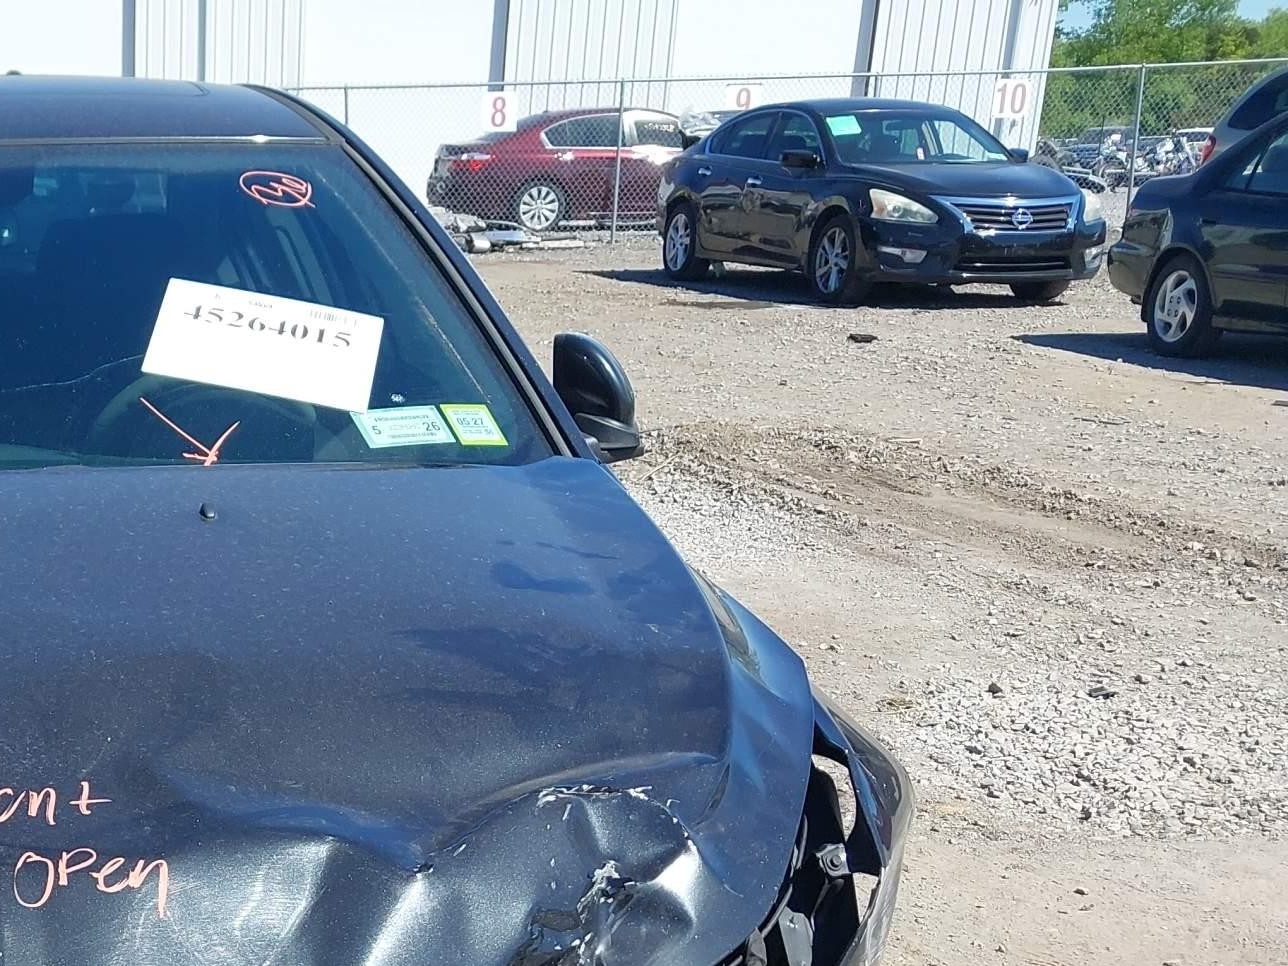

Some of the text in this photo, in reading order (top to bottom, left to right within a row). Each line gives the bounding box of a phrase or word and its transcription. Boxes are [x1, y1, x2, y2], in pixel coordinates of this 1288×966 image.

[491, 97, 507, 128] 8
[997, 82, 1027, 115] 10
[184, 305, 352, 348] 45264015
[372, 425, 382, 435] 5
[422, 421, 441, 432] 26
